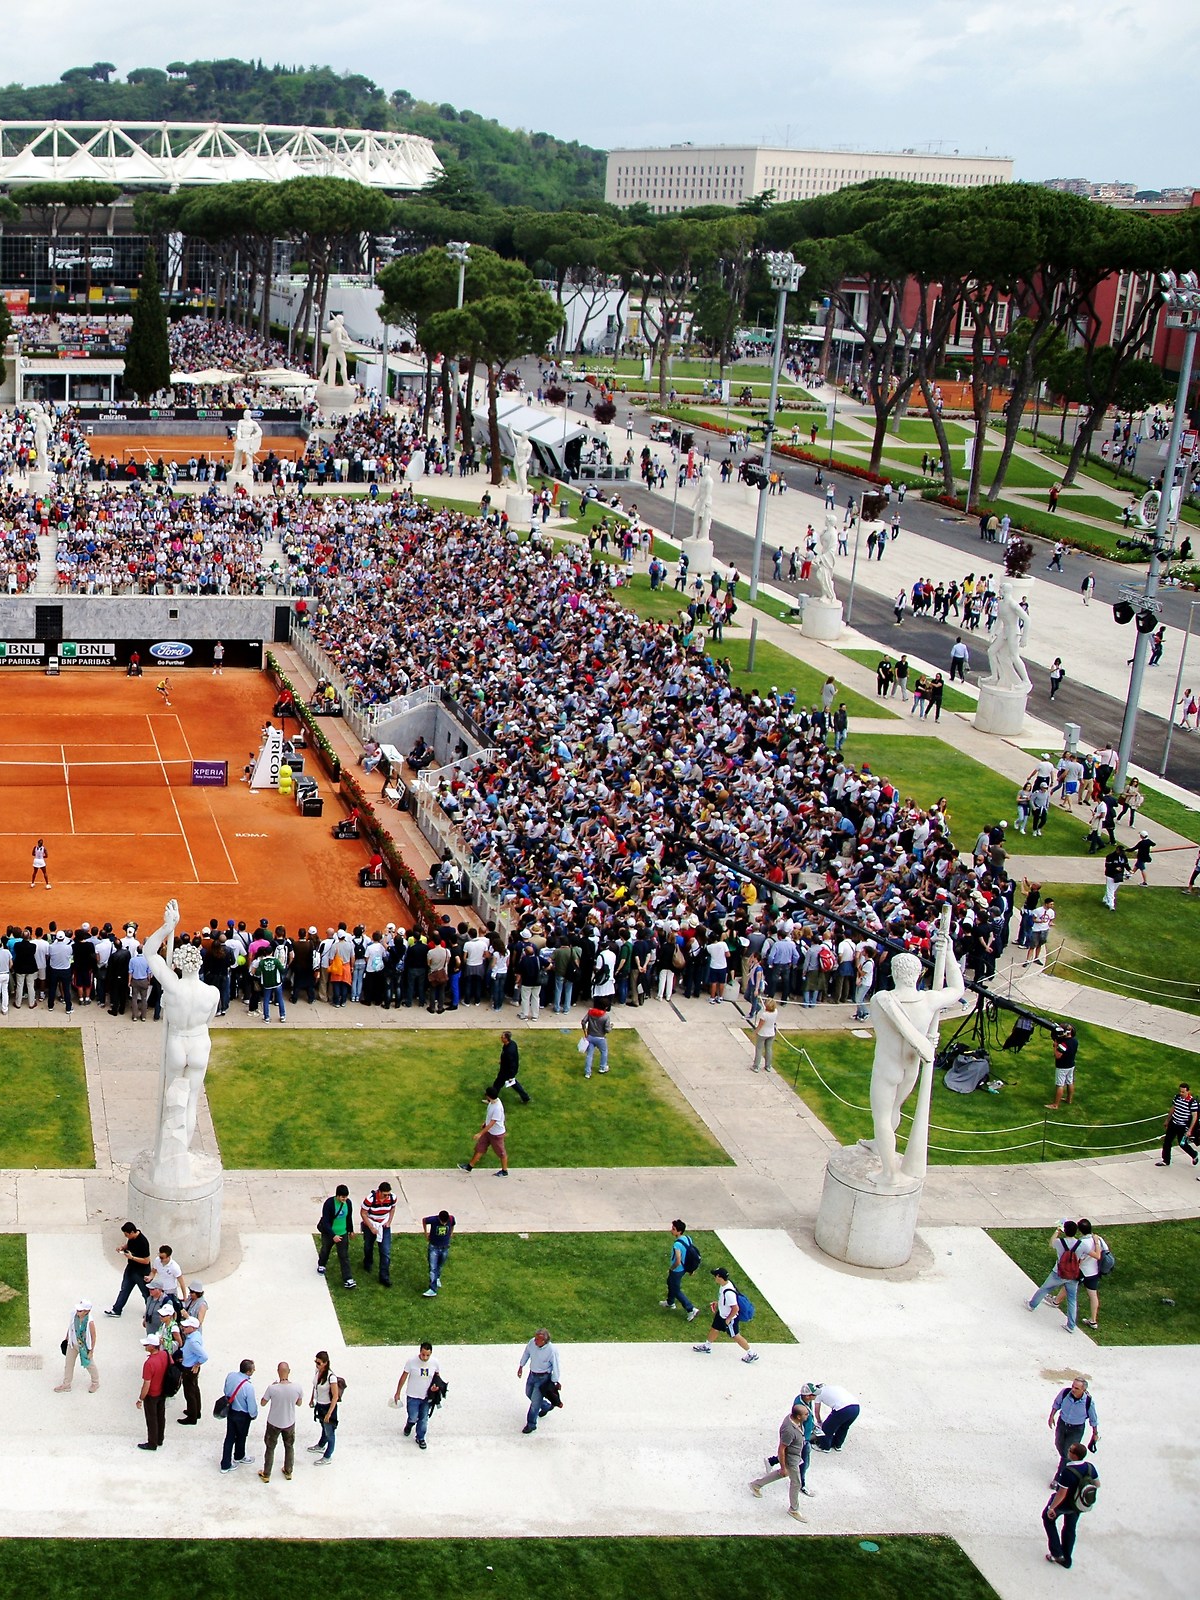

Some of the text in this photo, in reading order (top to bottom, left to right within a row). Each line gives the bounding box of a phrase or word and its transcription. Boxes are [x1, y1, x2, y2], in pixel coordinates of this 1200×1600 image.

[8, 644, 40, 655] BNL
[79, 644, 110, 655] BNL
[269, 740, 281, 785] RICOH
[193, 768, 224, 776] XPERIA
